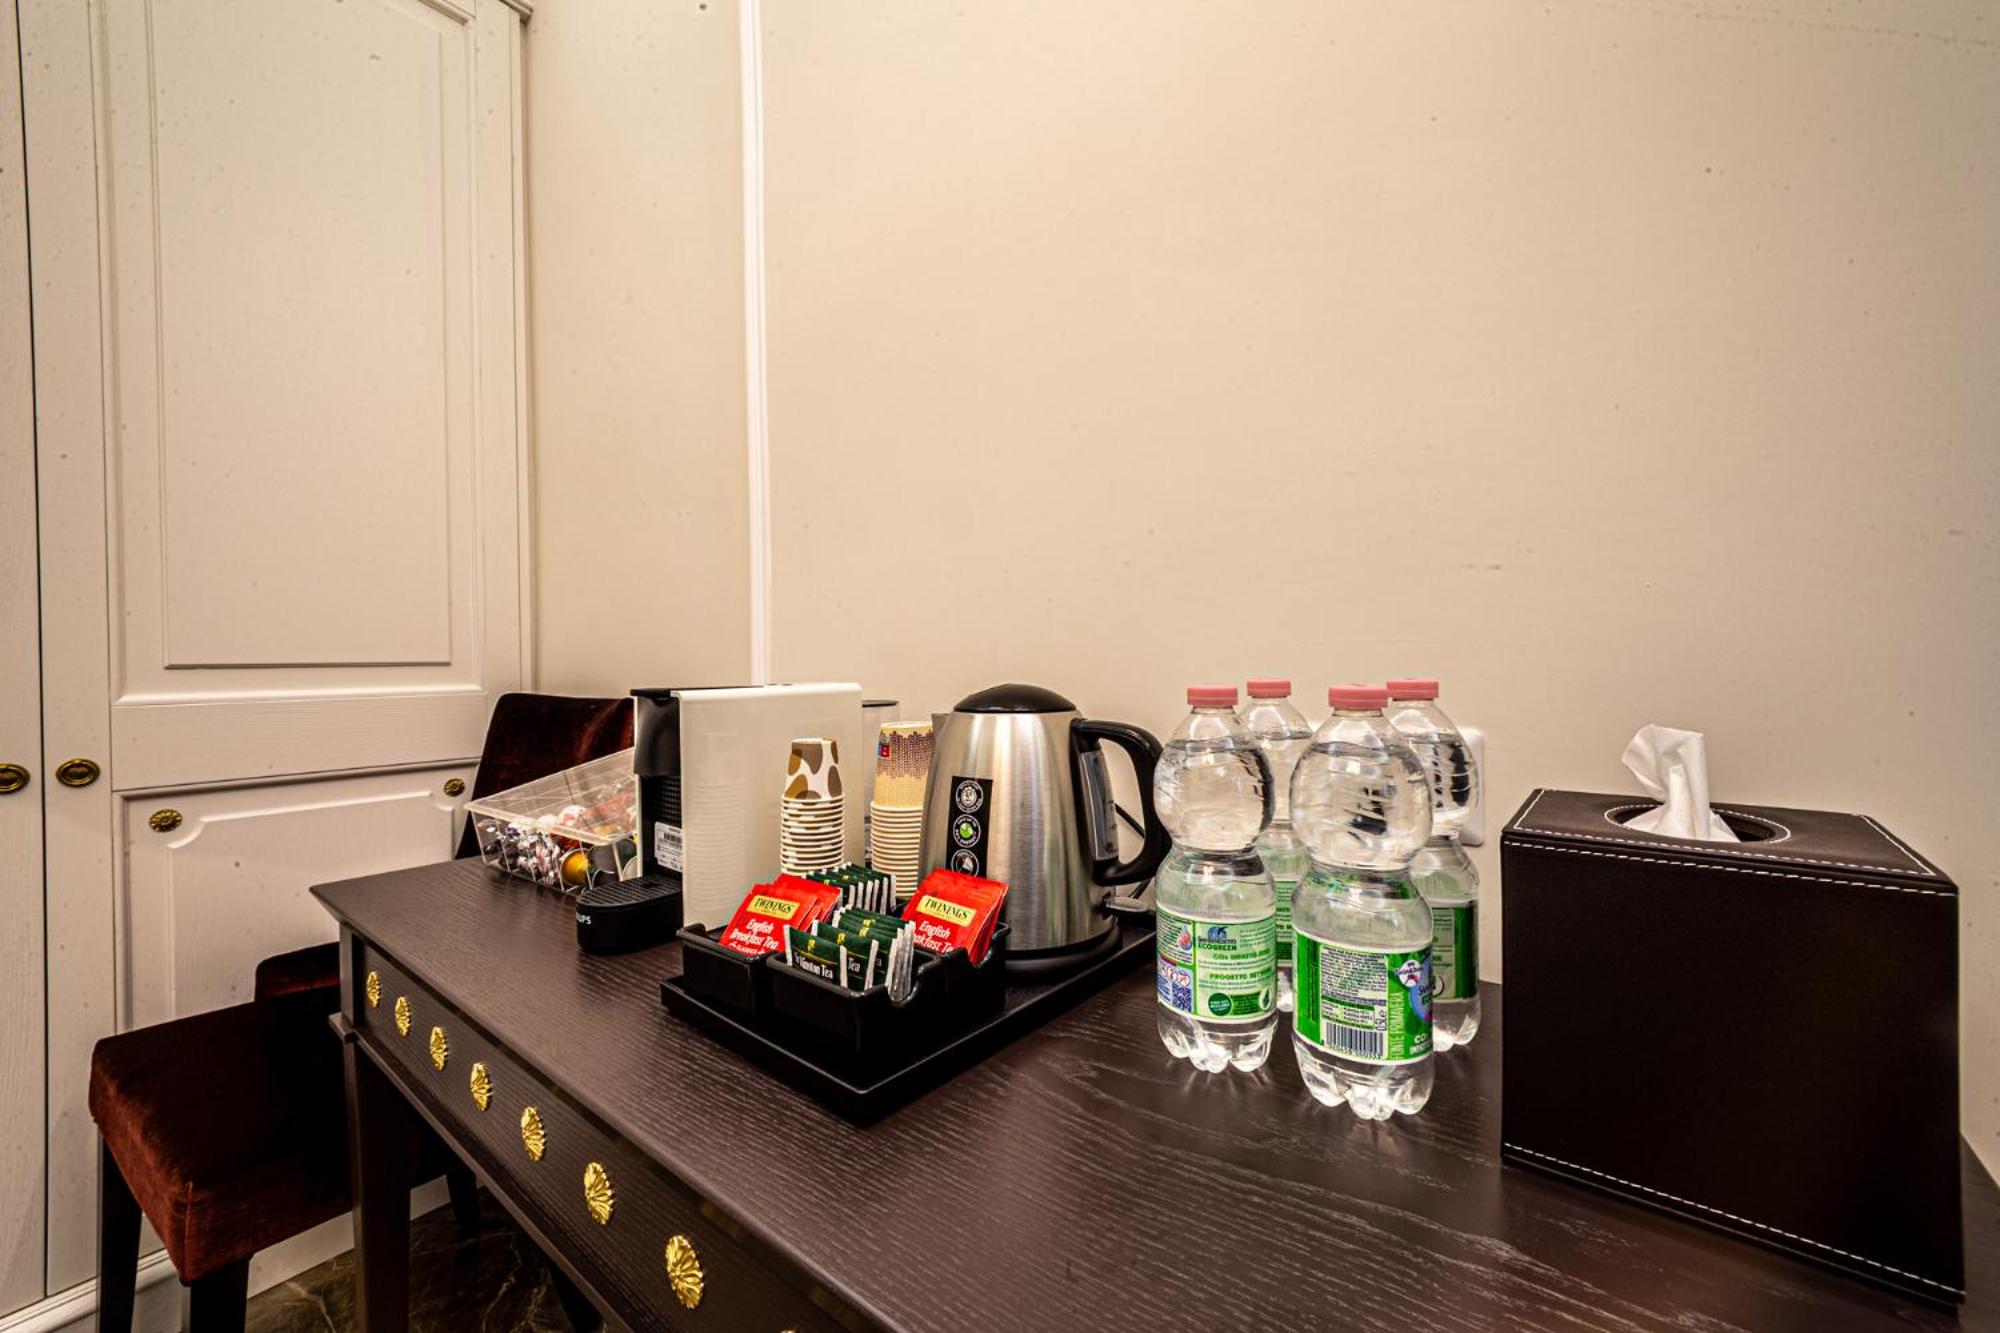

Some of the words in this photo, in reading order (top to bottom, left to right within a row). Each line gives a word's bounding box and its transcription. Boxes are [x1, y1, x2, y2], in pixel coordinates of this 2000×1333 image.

[754, 898, 794, 914] TWININGS
[924, 898, 969, 920] TWININGS
[746, 918, 774, 935] English
[919, 920, 951, 939] English
[729, 928, 765, 947] Breakfast
[763, 936, 779, 950] Tea
[821, 964, 834, 979] Tea
[848, 957, 861, 973] Tea
